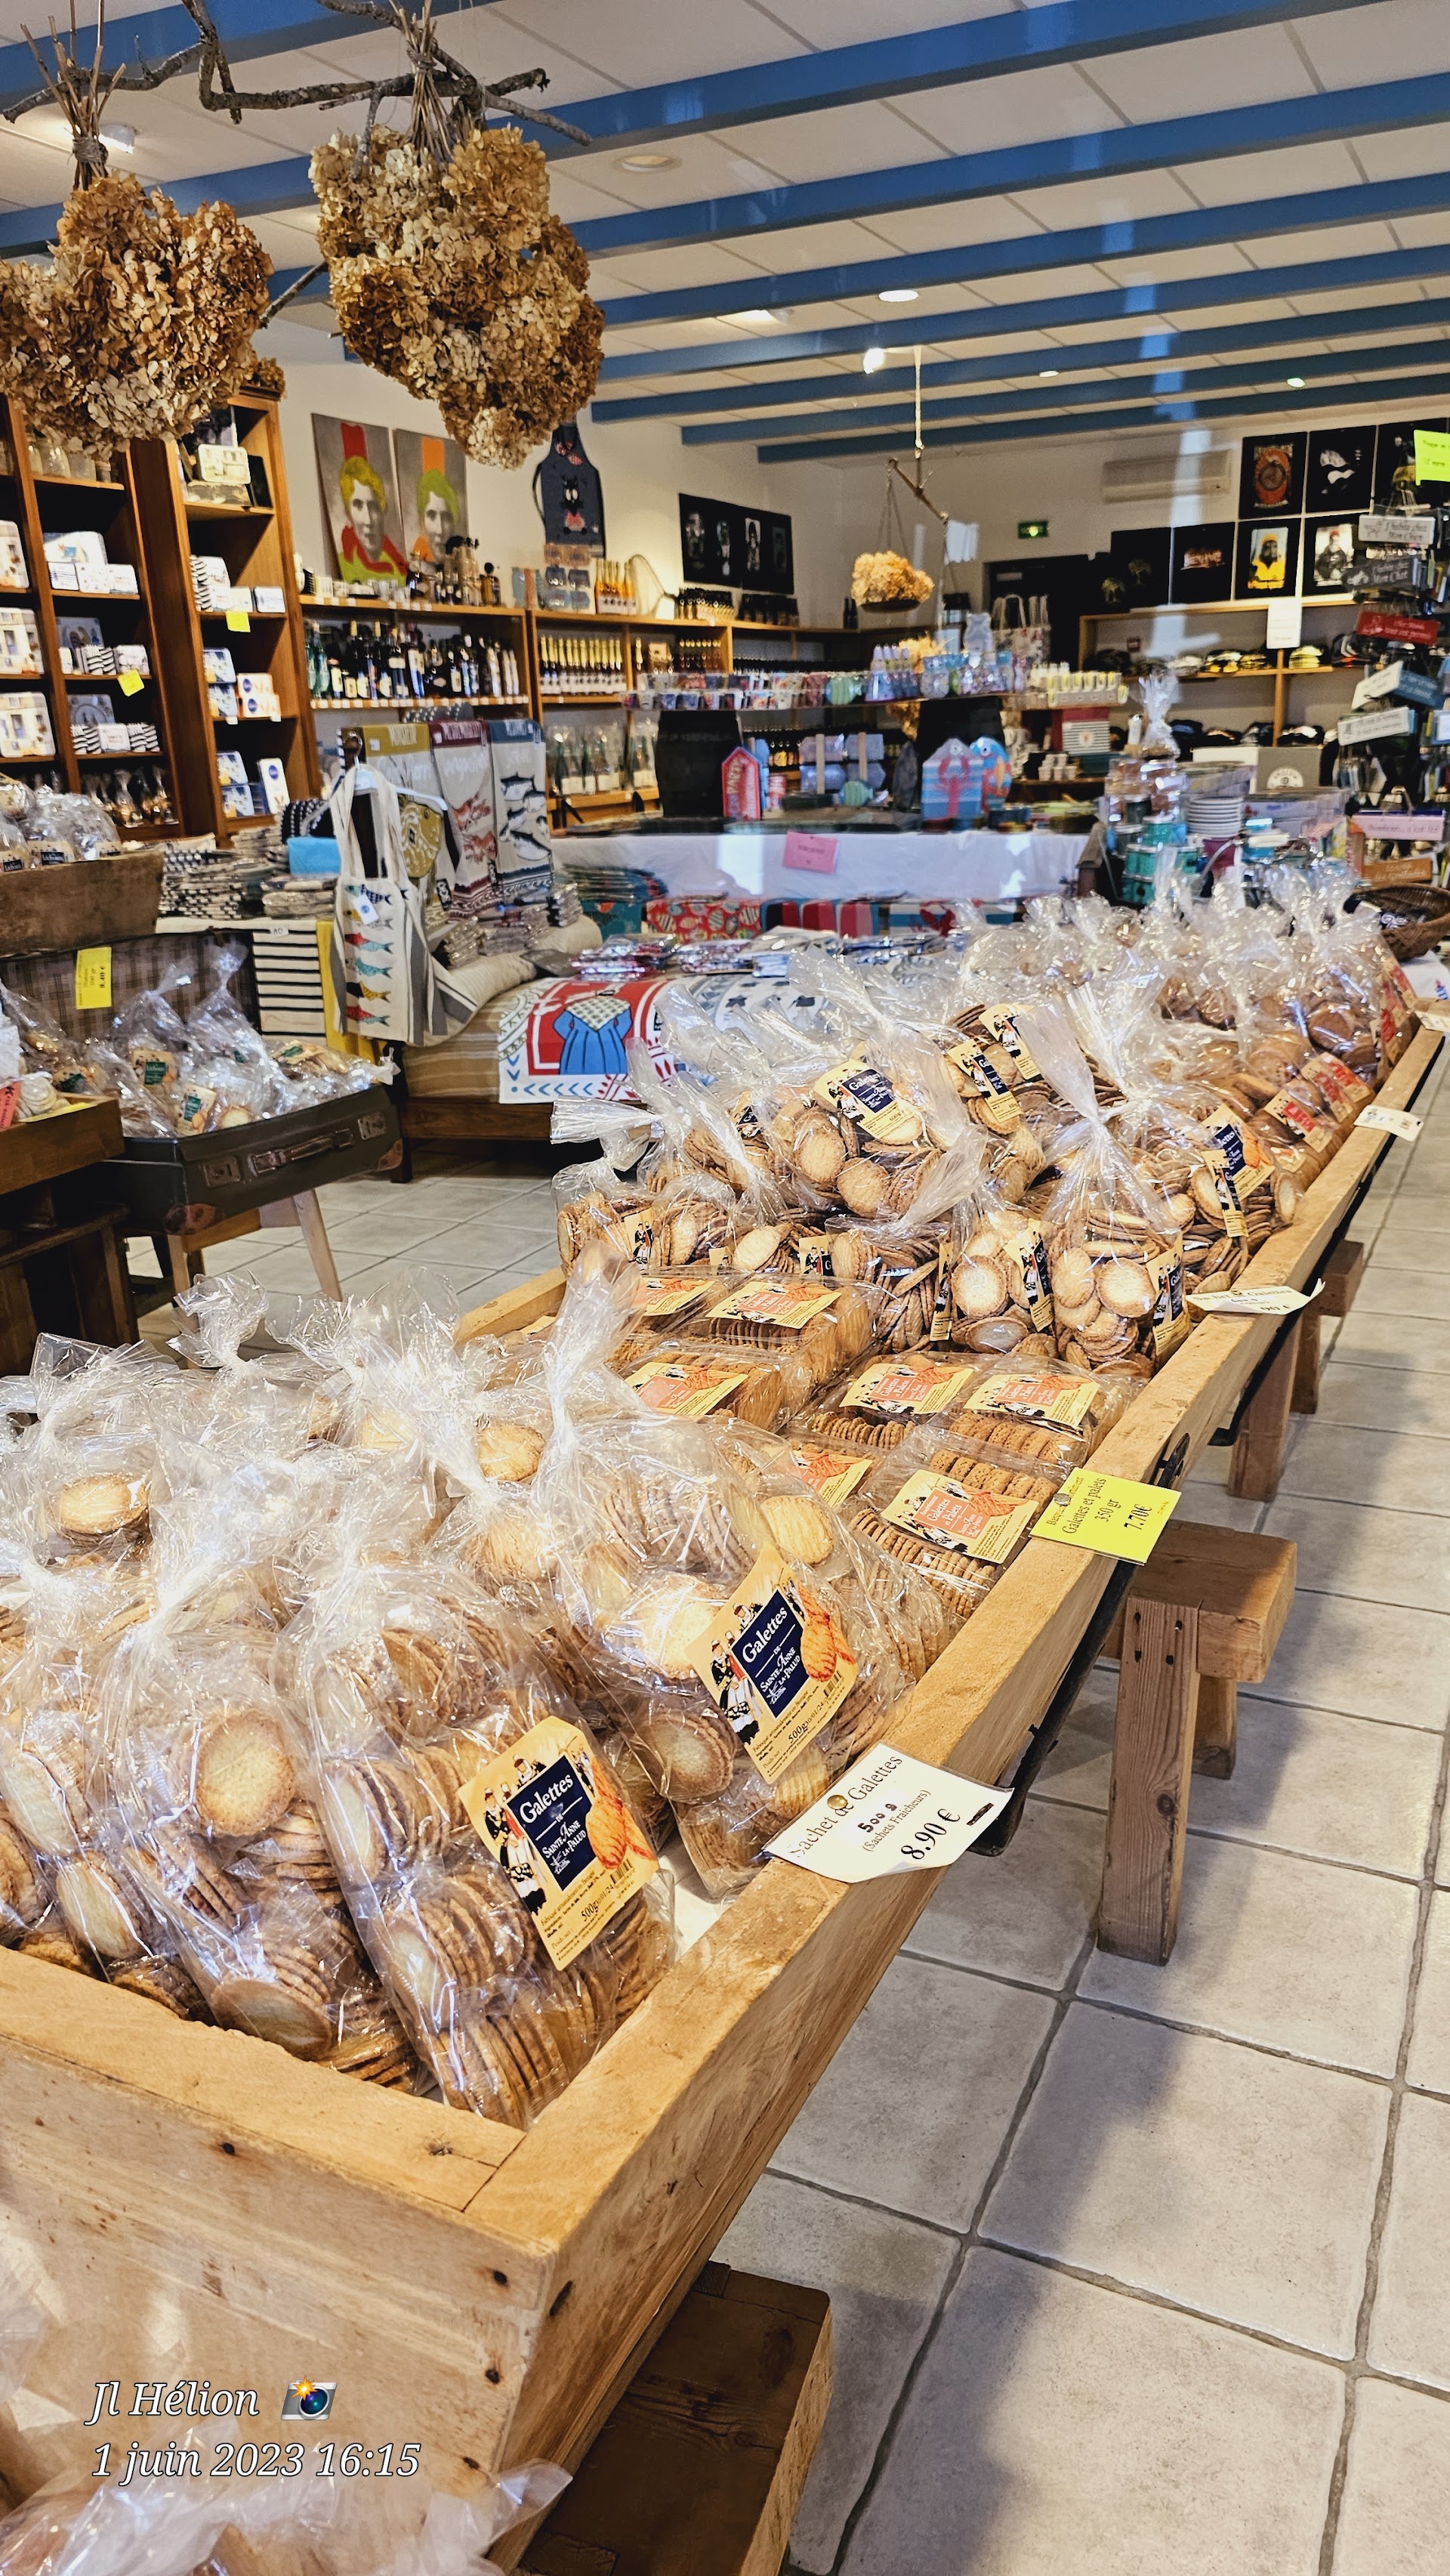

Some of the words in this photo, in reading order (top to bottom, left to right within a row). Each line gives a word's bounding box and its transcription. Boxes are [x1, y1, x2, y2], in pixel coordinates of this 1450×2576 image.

[1217, 1132, 1236, 1147] lettes
[1088, 1478, 1106, 1499] palets
[927, 1499, 951, 1521] Galettes
[942, 1505, 962, 1520] Palets
[1084, 1497, 1093, 1506] et
[1095, 1507, 1114, 1522] 350
[1107, 1499, 1121, 1509] gr
[1062, 1506, 1090, 1534] Galettes
[742, 1607, 788, 1663] Galettes
[786, 1722, 808, 1744] 500g
[520, 1774, 573, 1823] Galettes
[788, 1815, 838, 1858] Sachet
[847, 1755, 902, 1800] Galettes
[857, 1813, 887, 1833] 500
[862, 1822, 895, 1852] (Sachets
[901, 1822, 947, 1861] 8.90
[937, 1808, 961, 1824] €
[541, 1837, 565, 1858] SAINTE
[580, 1900, 598, 1922] 500g
